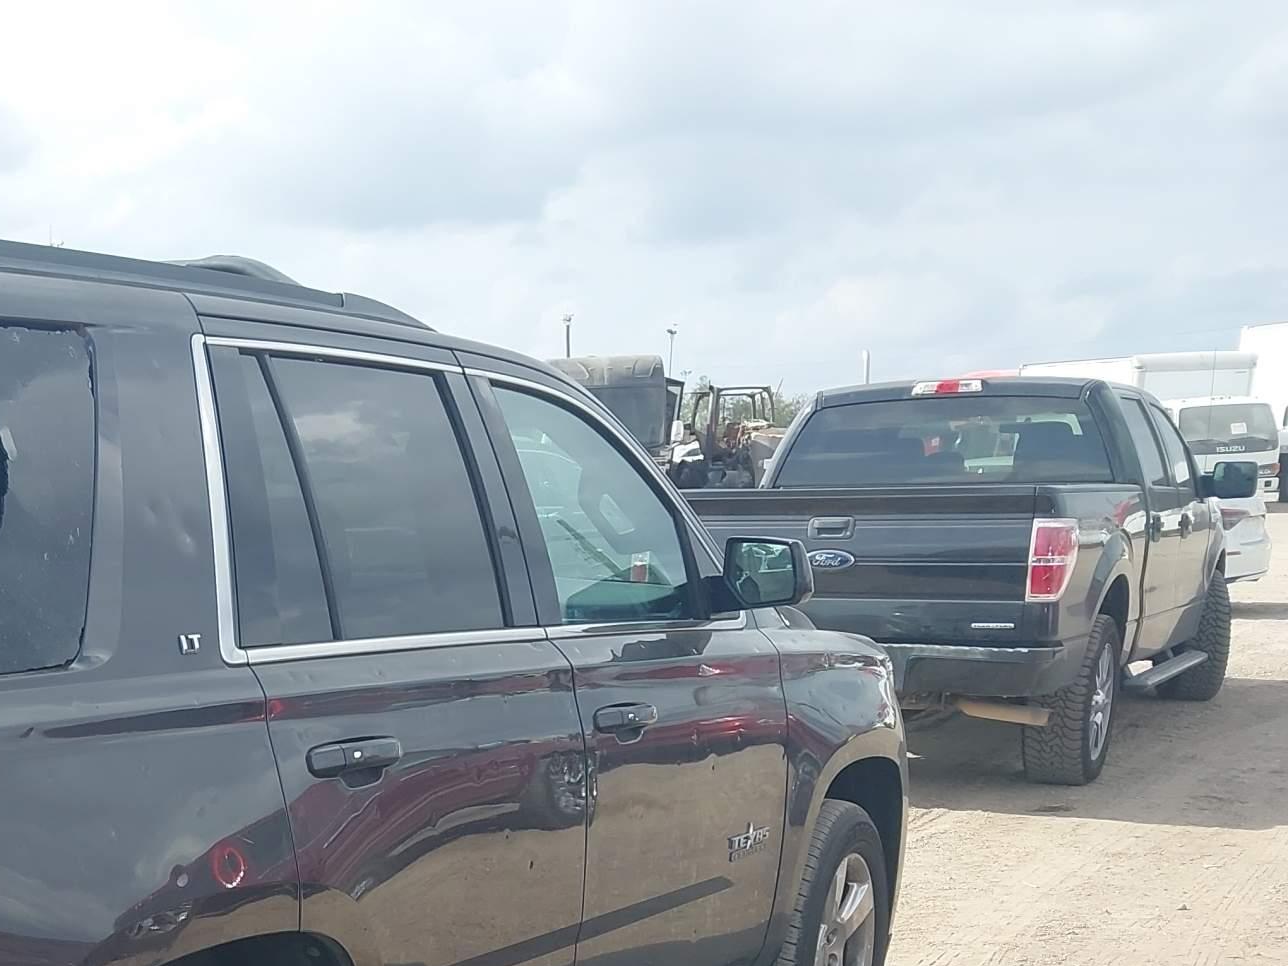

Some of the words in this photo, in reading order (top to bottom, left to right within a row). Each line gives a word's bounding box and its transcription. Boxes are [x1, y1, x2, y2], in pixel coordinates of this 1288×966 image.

[1215, 445, 1246, 453] ISUZU
[812, 553, 842, 567] Ford
[178, 634, 201, 655] LT
[728, 822, 771, 852] TEXAS
